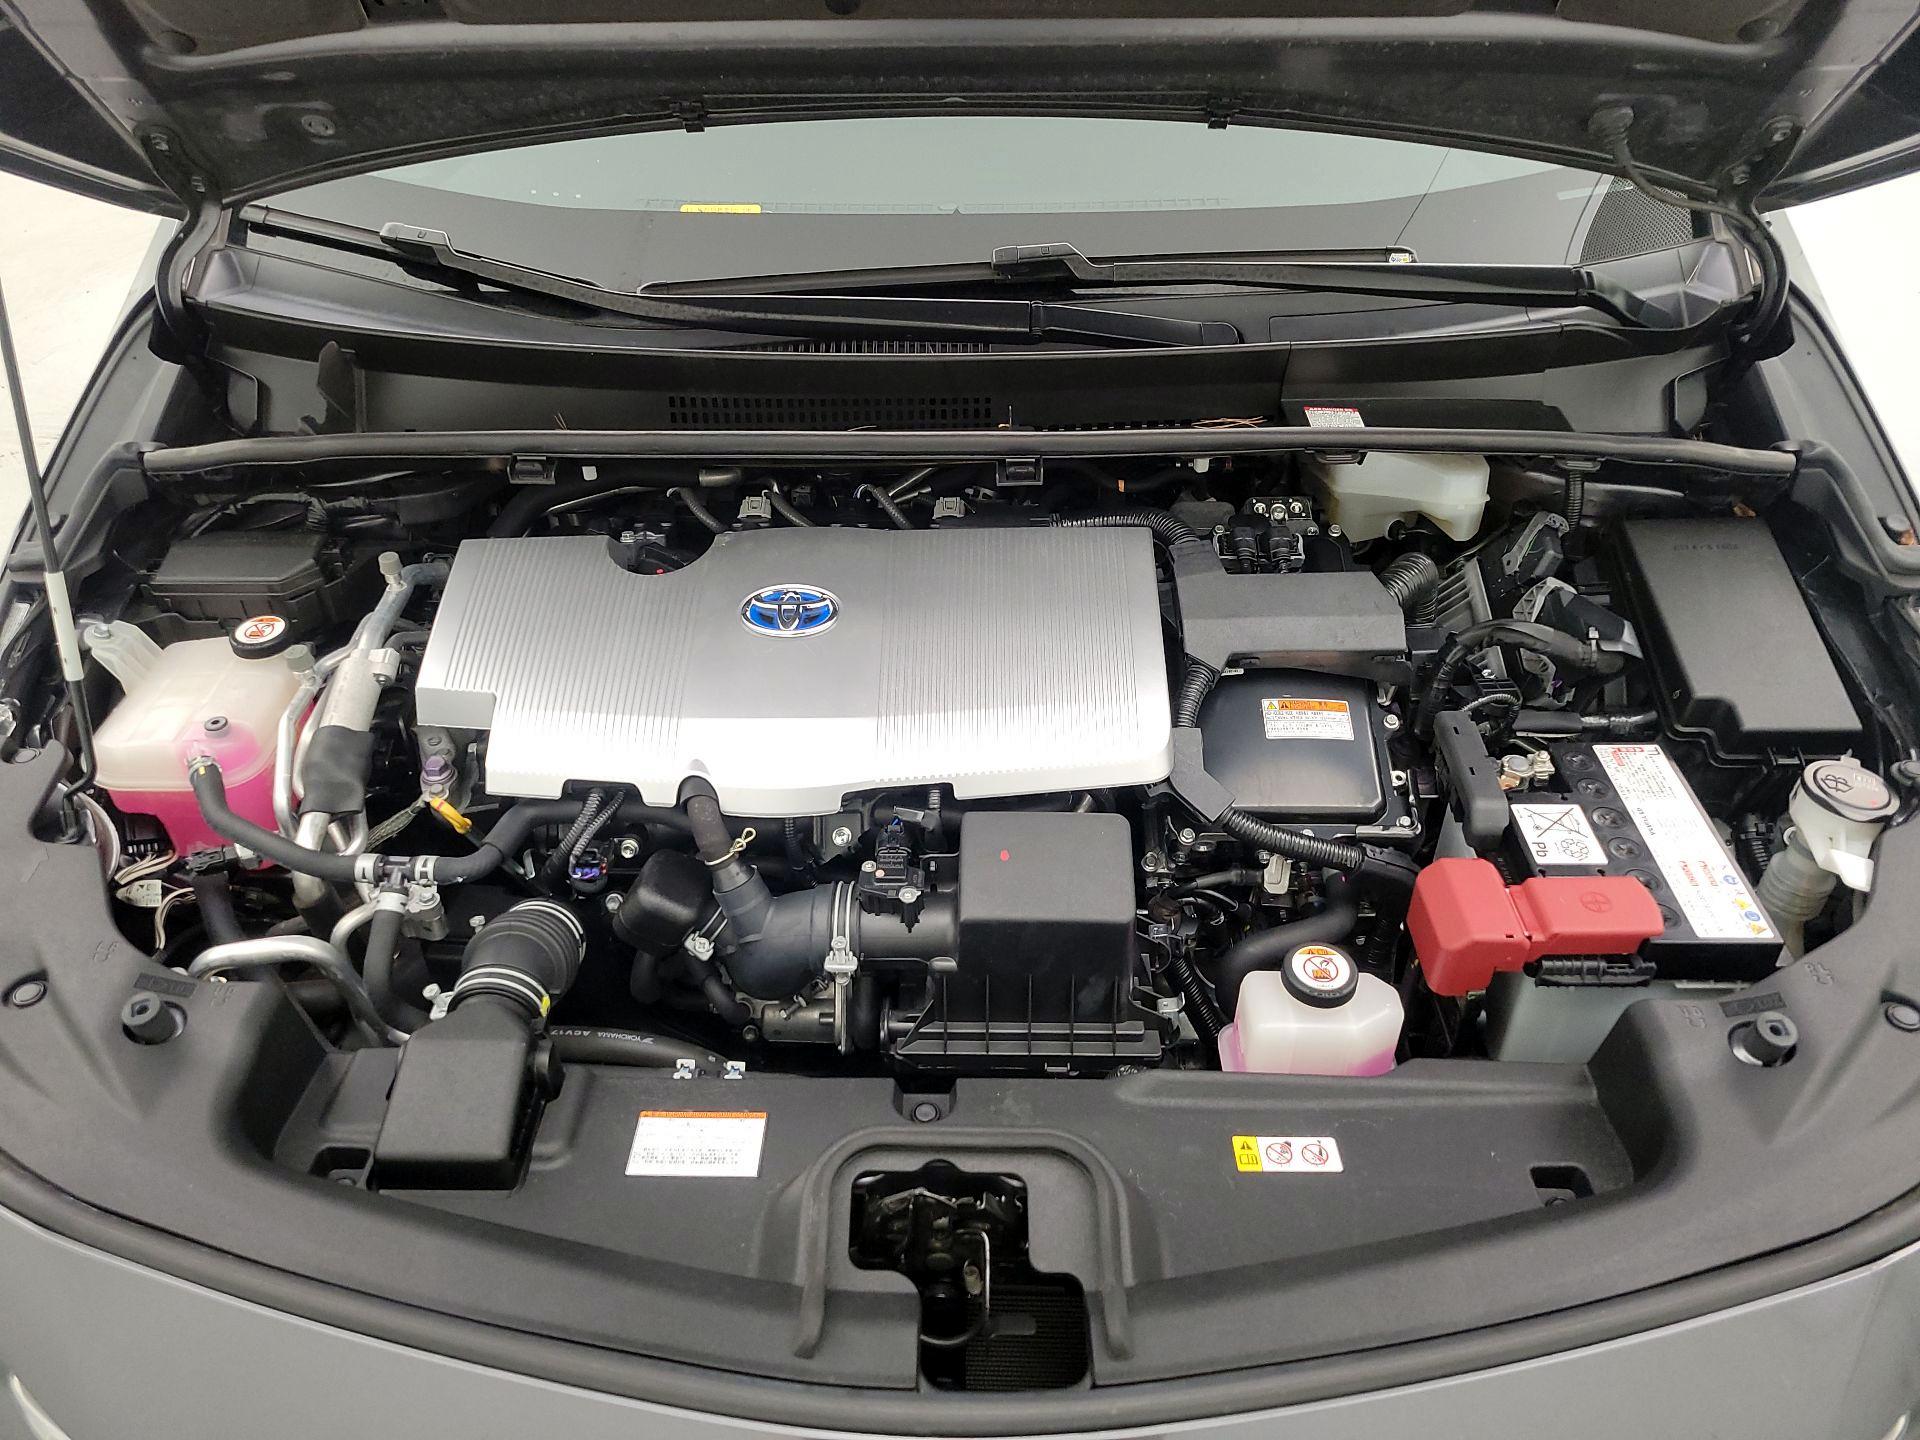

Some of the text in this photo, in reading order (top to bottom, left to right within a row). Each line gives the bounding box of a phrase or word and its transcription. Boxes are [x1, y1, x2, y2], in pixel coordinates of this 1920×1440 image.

[1532, 841, 1548, 858] Pb
[551, 1029, 642, 1042] YOKOHAMA ACV17
